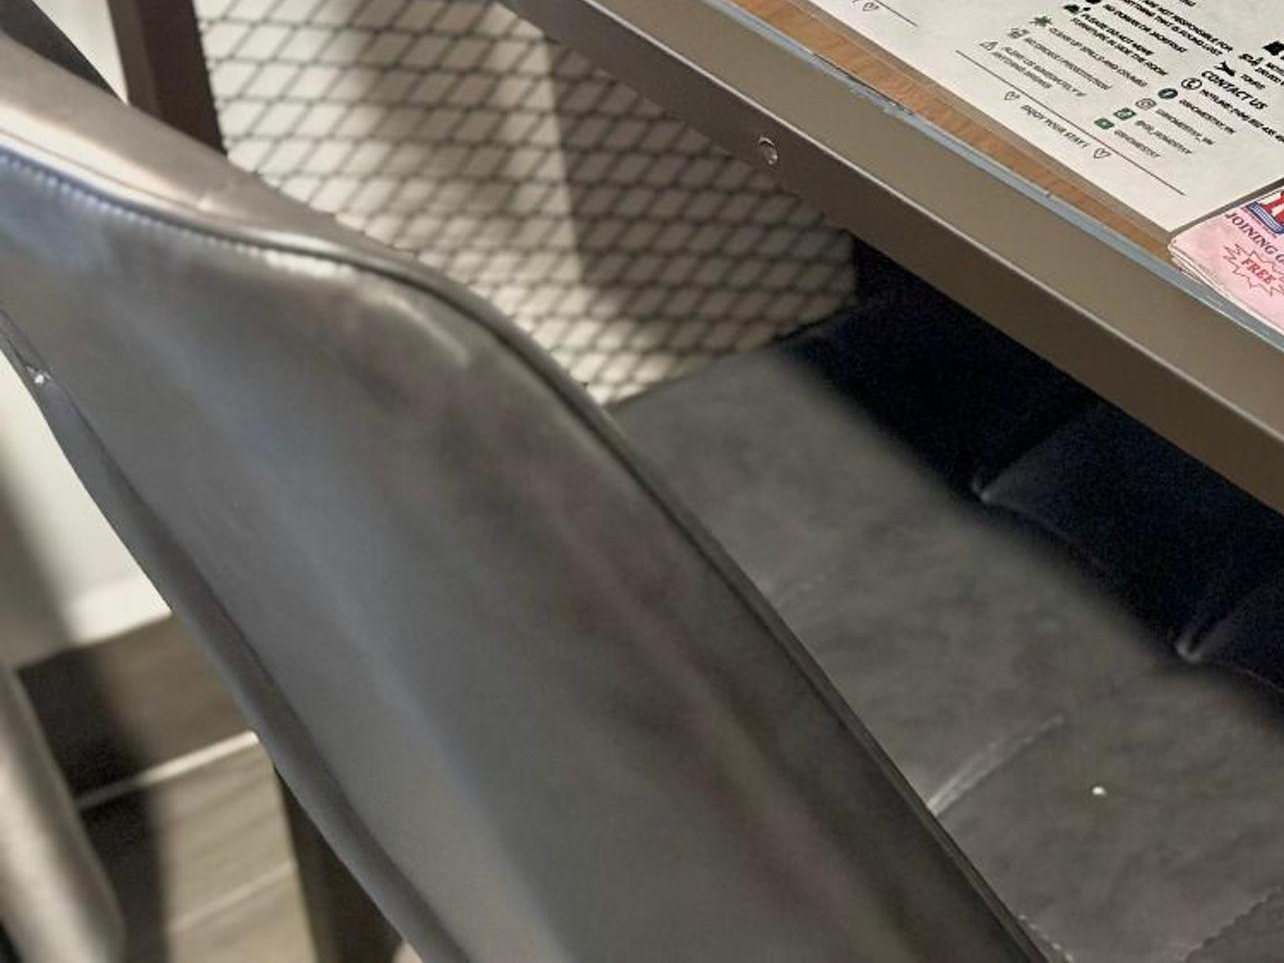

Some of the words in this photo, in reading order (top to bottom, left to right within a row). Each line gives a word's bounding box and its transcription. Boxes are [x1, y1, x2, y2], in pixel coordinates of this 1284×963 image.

[1199, 69, 1253, 101] CONTACT
[1224, 212, 1276, 257] JOINING
[1239, 253, 1278, 285] FREE
